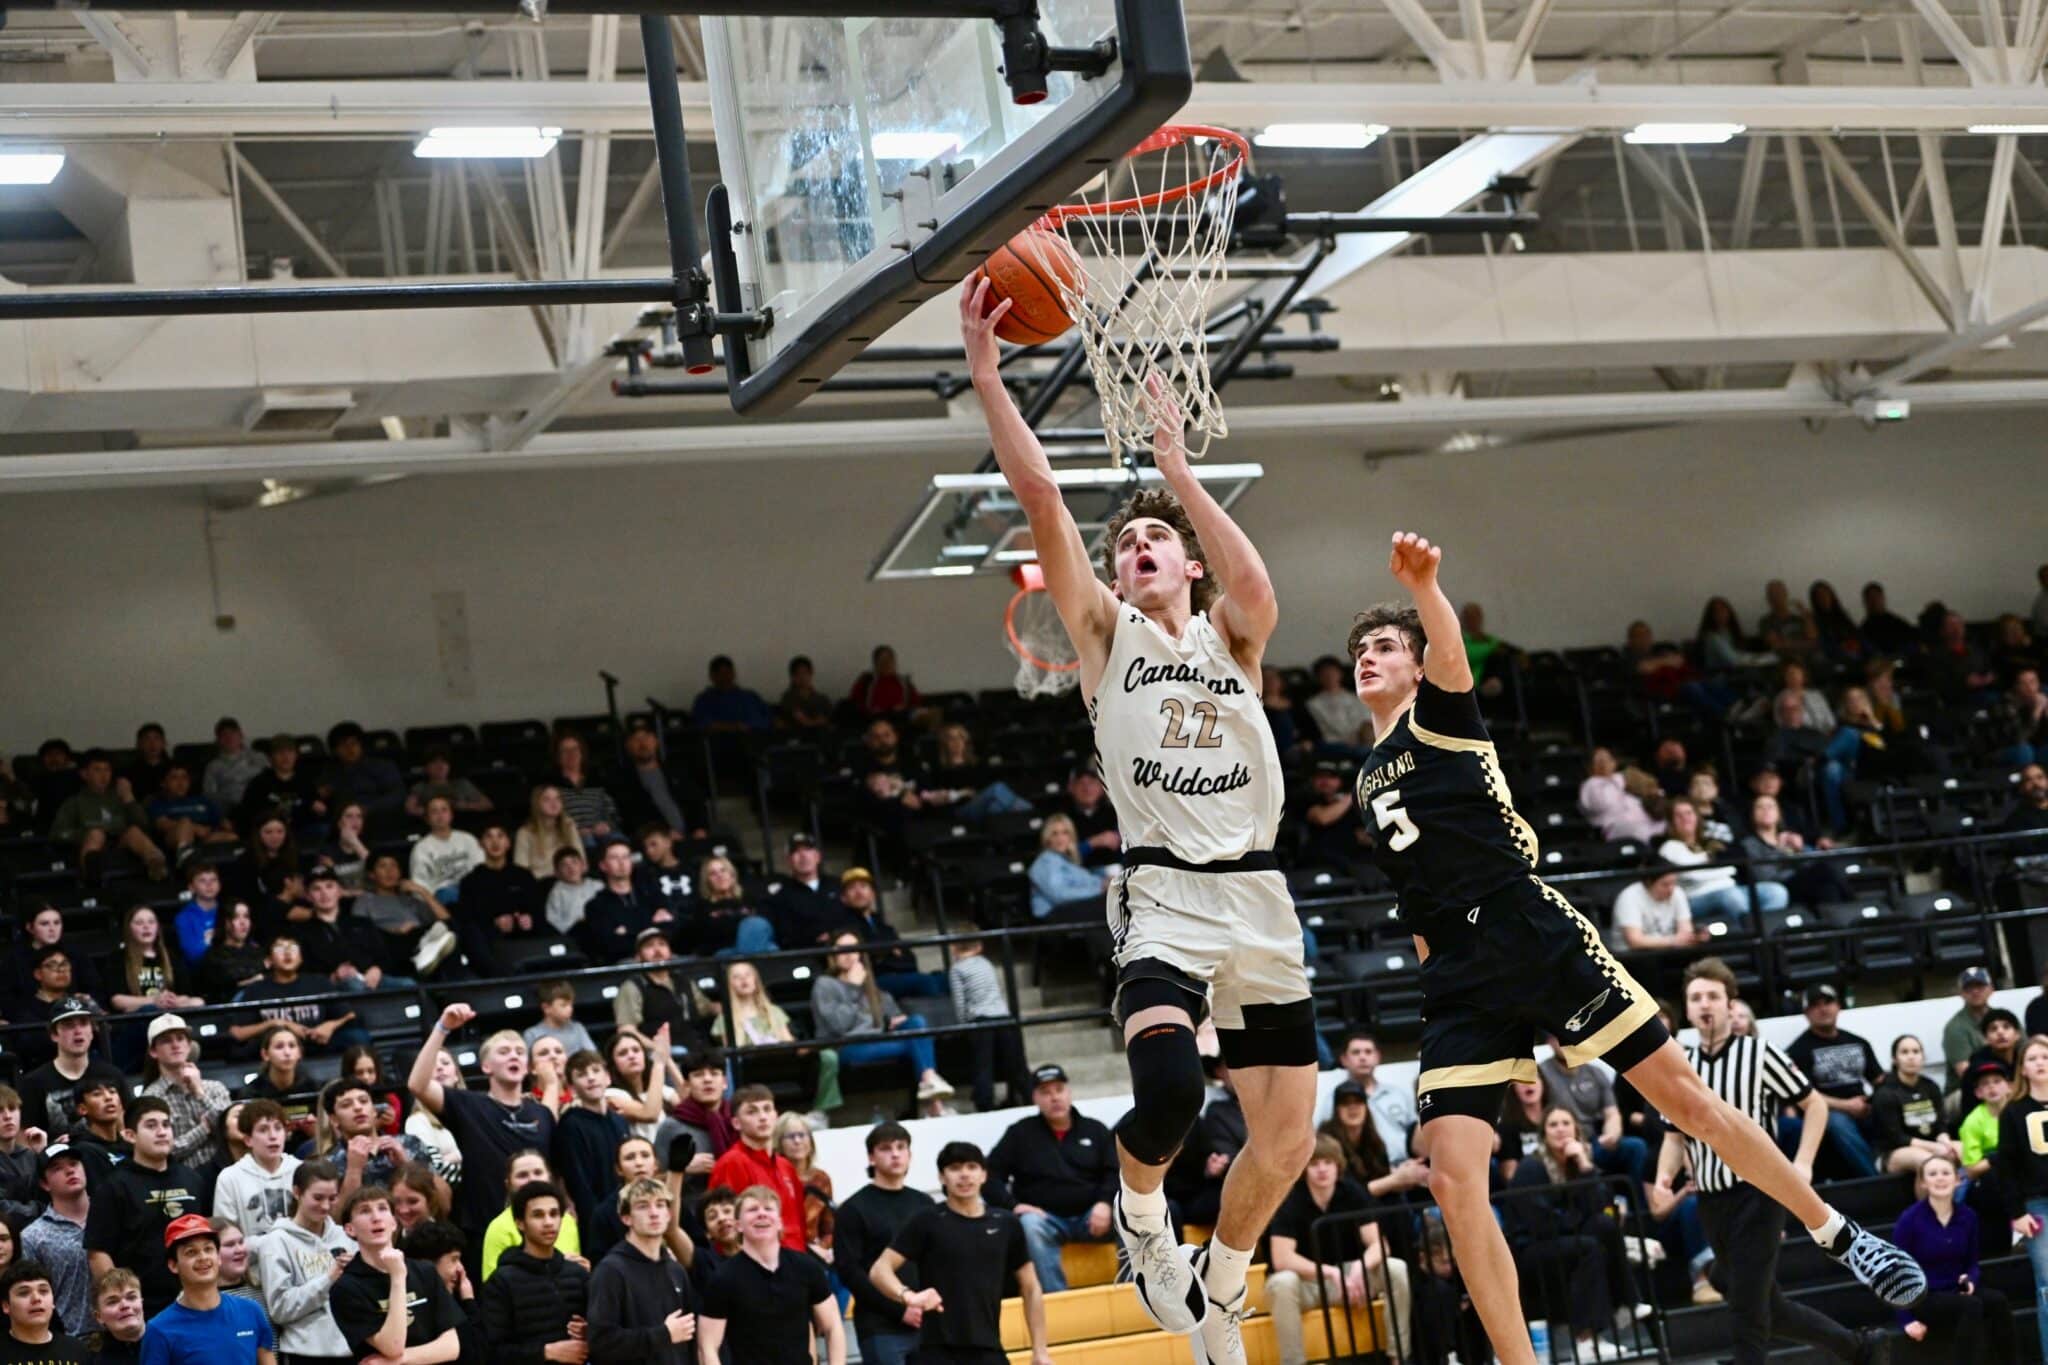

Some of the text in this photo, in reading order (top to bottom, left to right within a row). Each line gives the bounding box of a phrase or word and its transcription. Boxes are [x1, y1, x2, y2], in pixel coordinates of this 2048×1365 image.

[1124, 656, 1245, 695] Canaan
[1160, 698, 1223, 749] 22
[1132, 756, 1251, 796] Wildcats
[1371, 789, 1421, 852] 5
